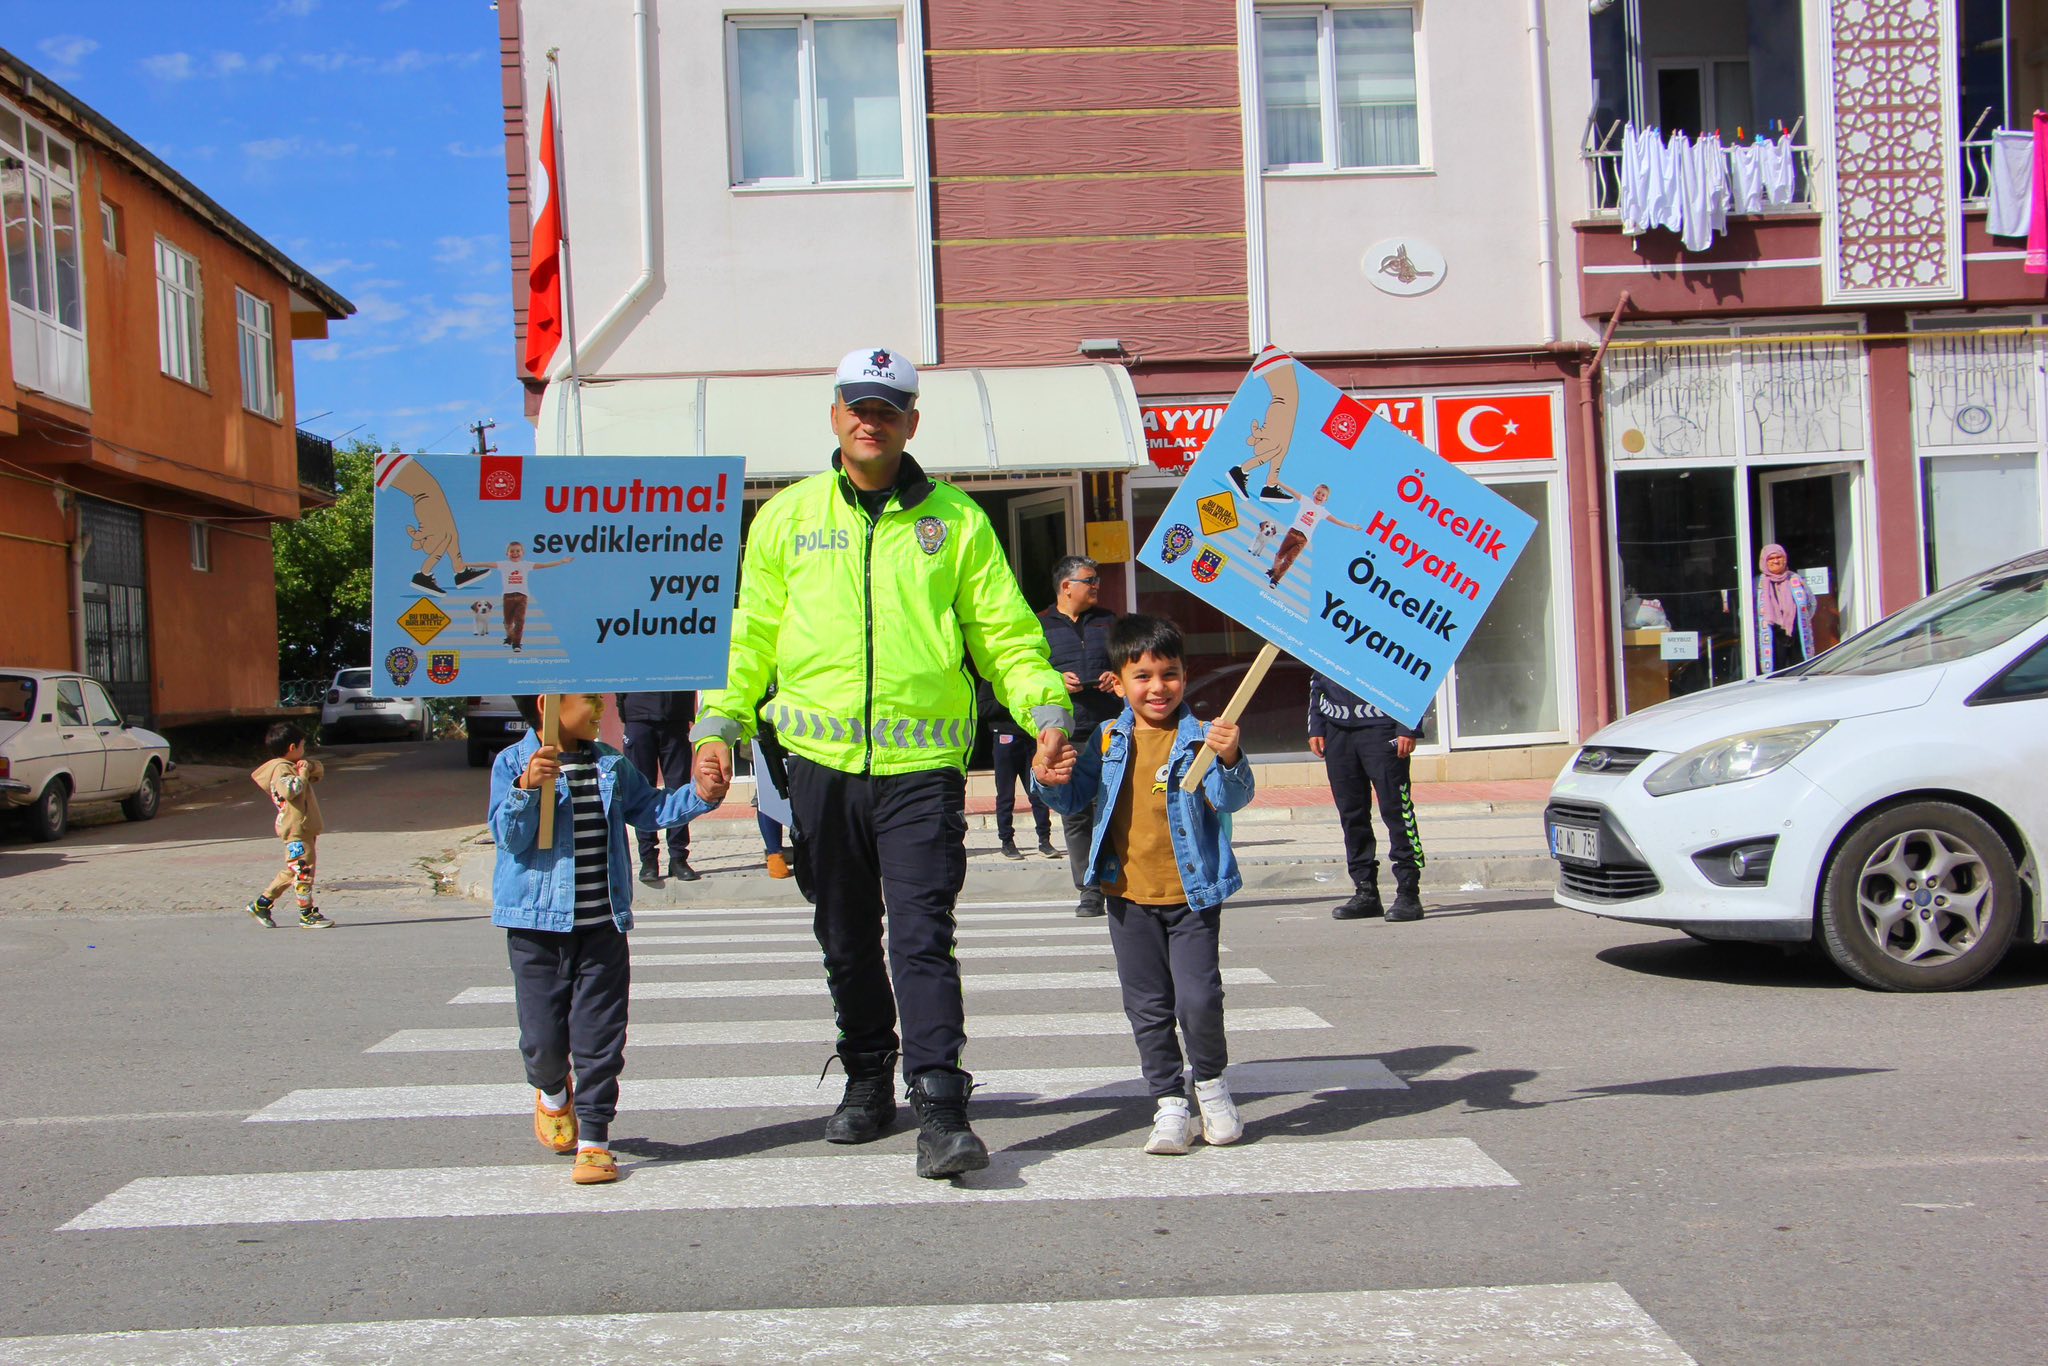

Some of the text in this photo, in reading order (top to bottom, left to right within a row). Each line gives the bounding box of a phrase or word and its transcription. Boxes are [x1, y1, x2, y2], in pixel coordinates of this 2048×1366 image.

[545, 473, 727, 513] unutma!
[1397, 468, 1507, 561] Öncelik
[533, 525, 724, 554] sevdiklerinde
[1365, 510, 1481, 601] Hayatın
[650, 574, 719, 601] yaya
[1347, 550, 1458, 642] Öncelik
[1805, 575, 1824, 585] ERZİ
[596, 608, 717, 643] yolunda
[1319, 590, 1432, 682] Yayanın
